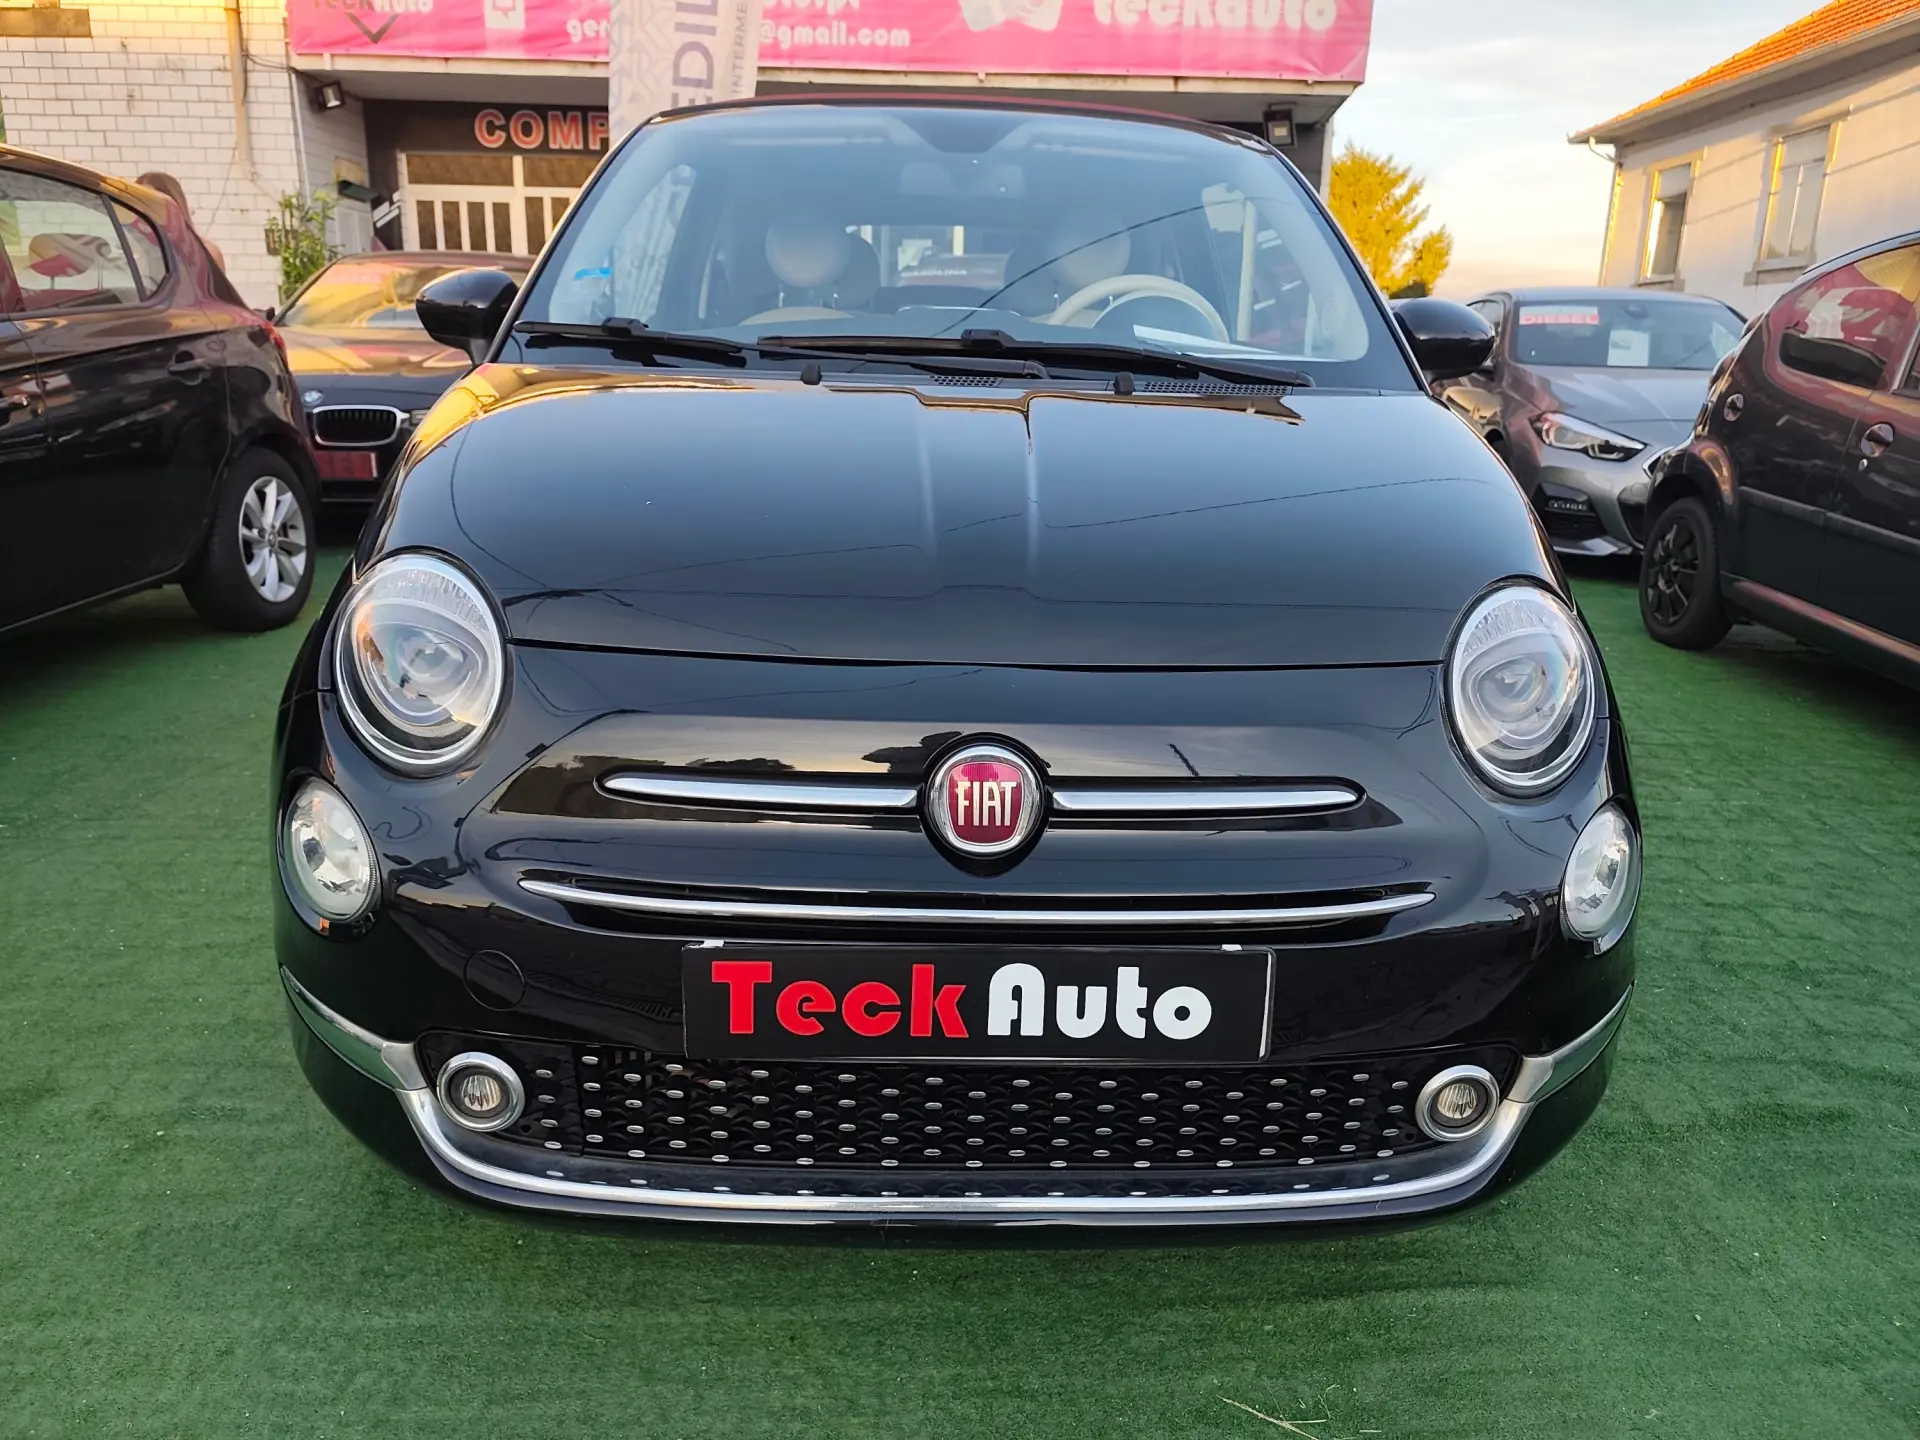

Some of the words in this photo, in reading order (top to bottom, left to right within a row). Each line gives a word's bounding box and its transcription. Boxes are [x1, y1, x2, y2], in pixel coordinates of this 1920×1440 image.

[474, 109, 609, 150] COMP
[956, 781, 1017, 827] FIAT
[711, 961, 969, 1038] Teck
[987, 963, 1212, 1040] Auto
